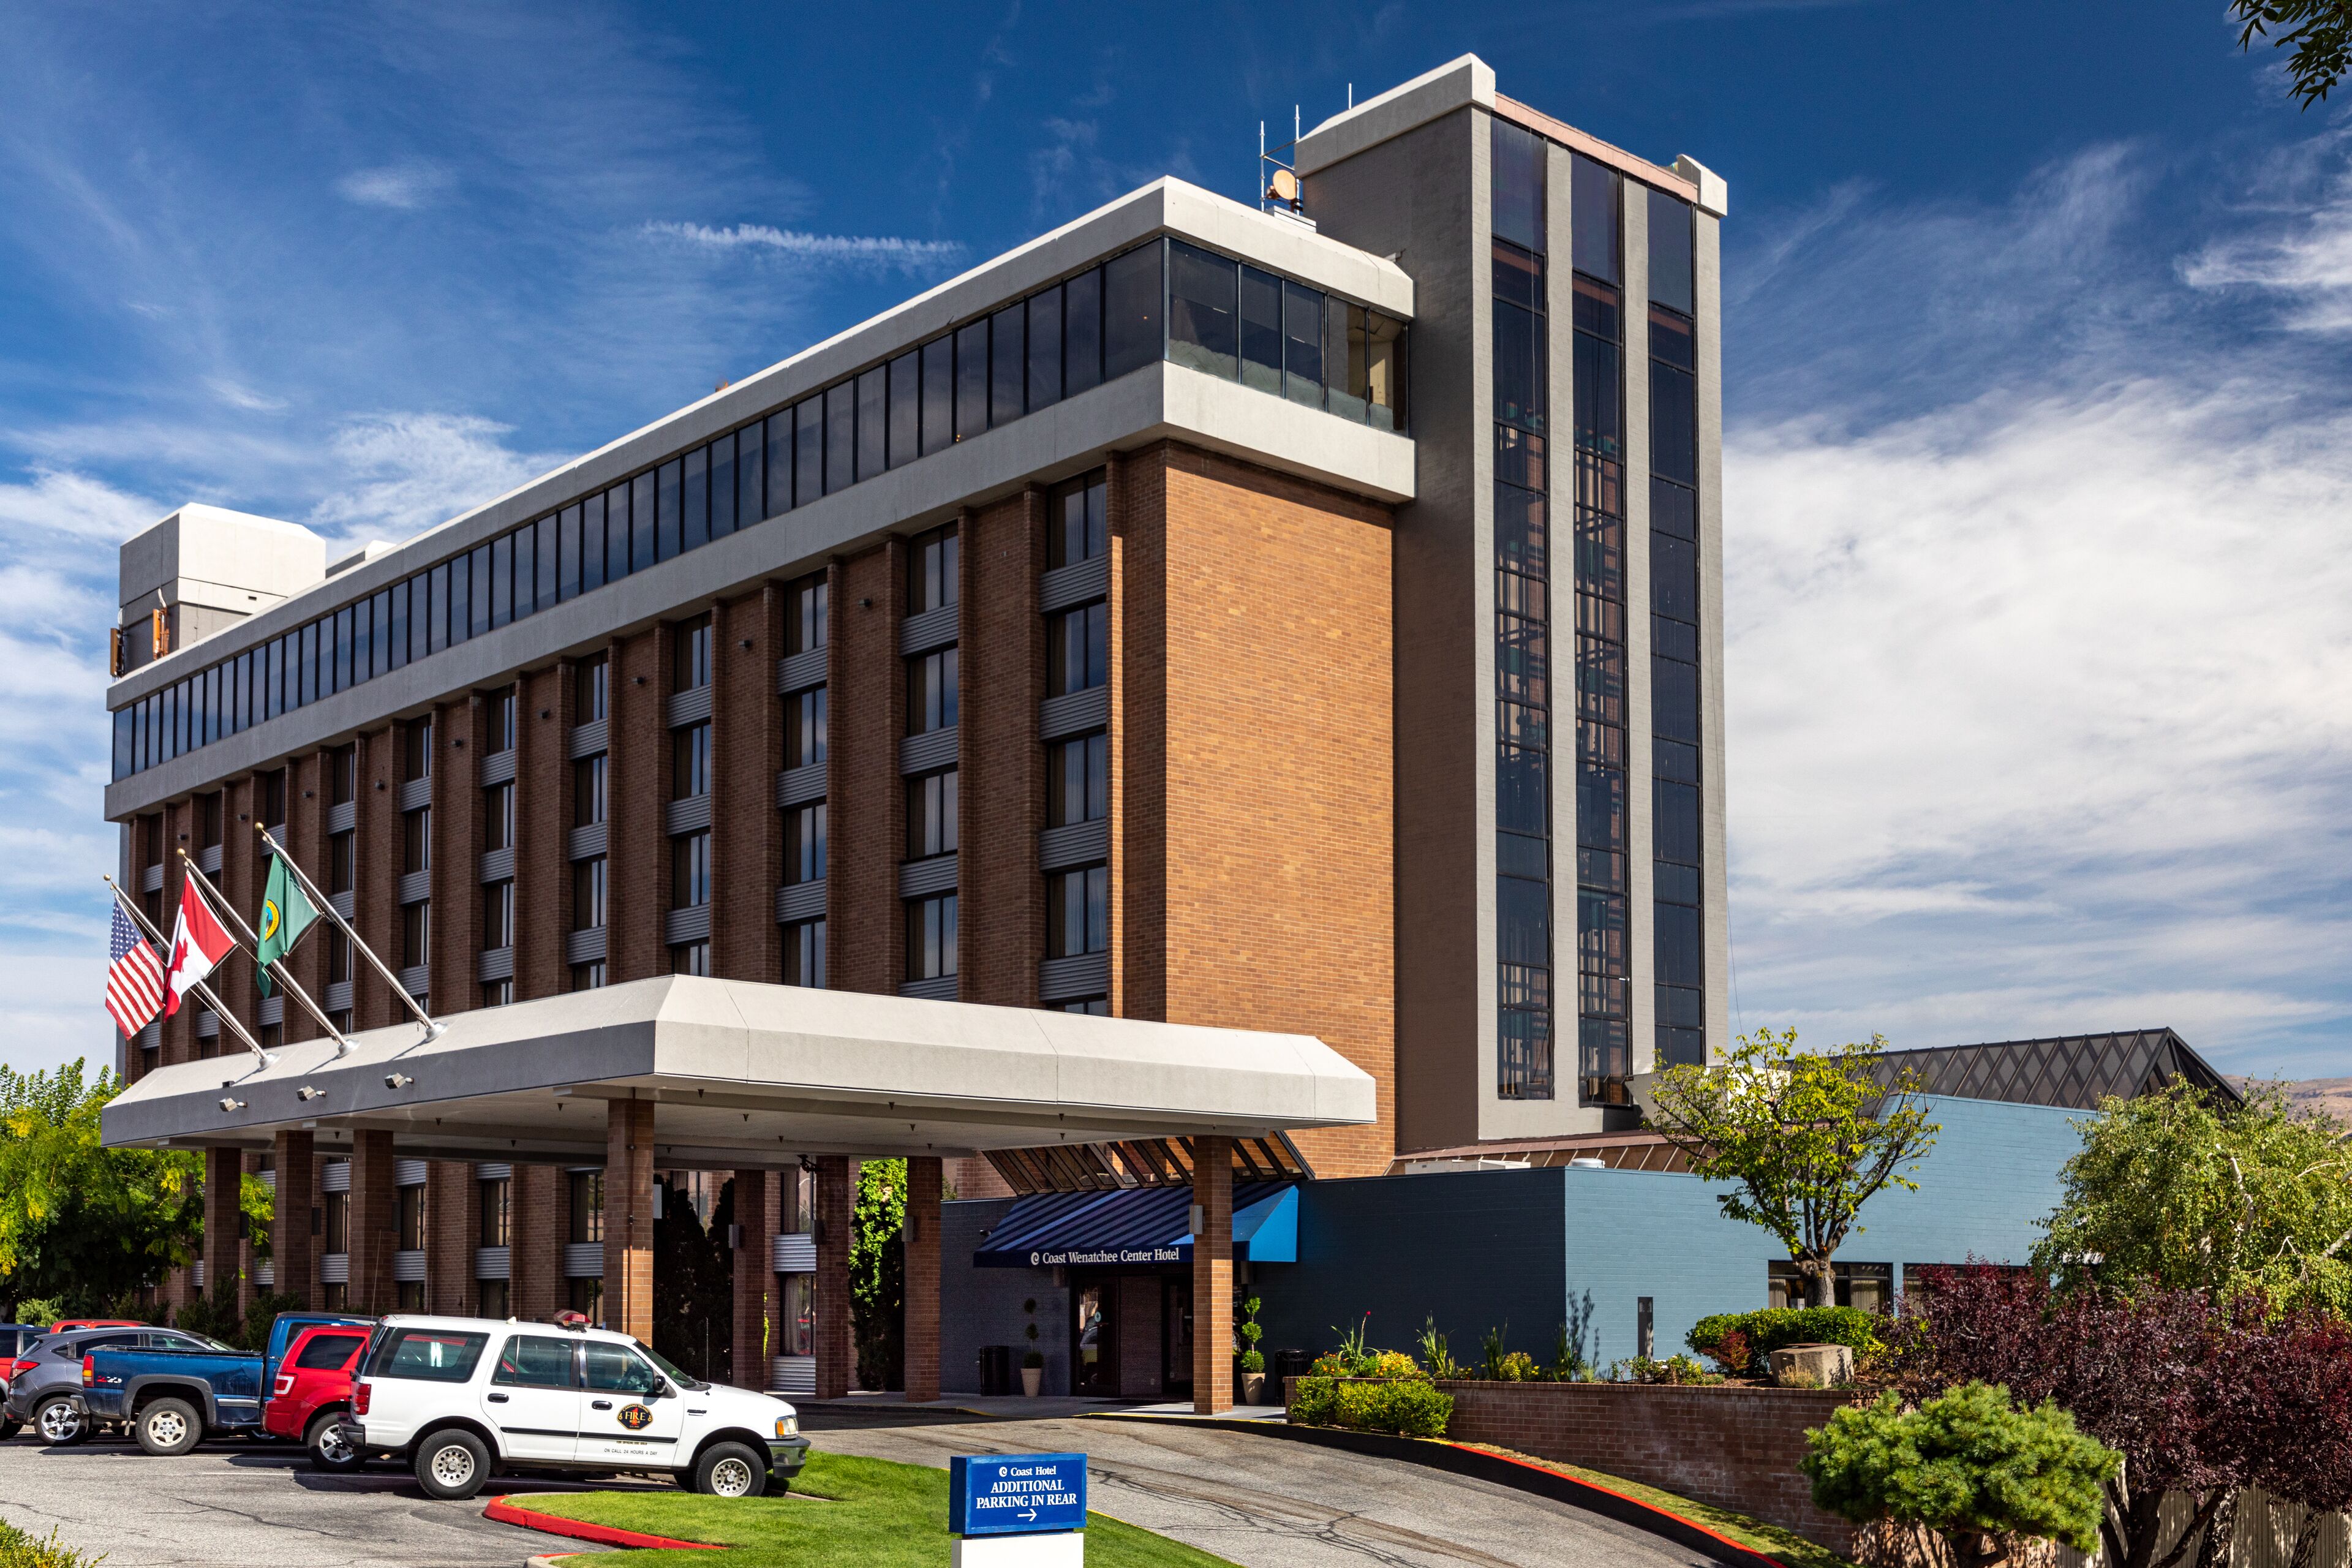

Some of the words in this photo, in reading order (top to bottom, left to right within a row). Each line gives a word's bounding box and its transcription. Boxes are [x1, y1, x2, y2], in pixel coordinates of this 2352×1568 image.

[1042, 1252, 1066, 1264] Coast
[1068, 1250, 1118, 1264] Wenatchee
[1121, 1250, 1152, 1262] Center
[1154, 1248, 1179, 1261] Hotel
[625, 1411, 646, 1421] FIRE
[1011, 1467, 1033, 1477] Coast
[1035, 1465, 1057, 1476] Hotel
[990, 1479, 1065, 1493] ADDITIONAL
[976, 1495, 1029, 1509] PARKING
[1031, 1494, 1044, 1506] IN
[1047, 1493, 1077, 1506] REAR
